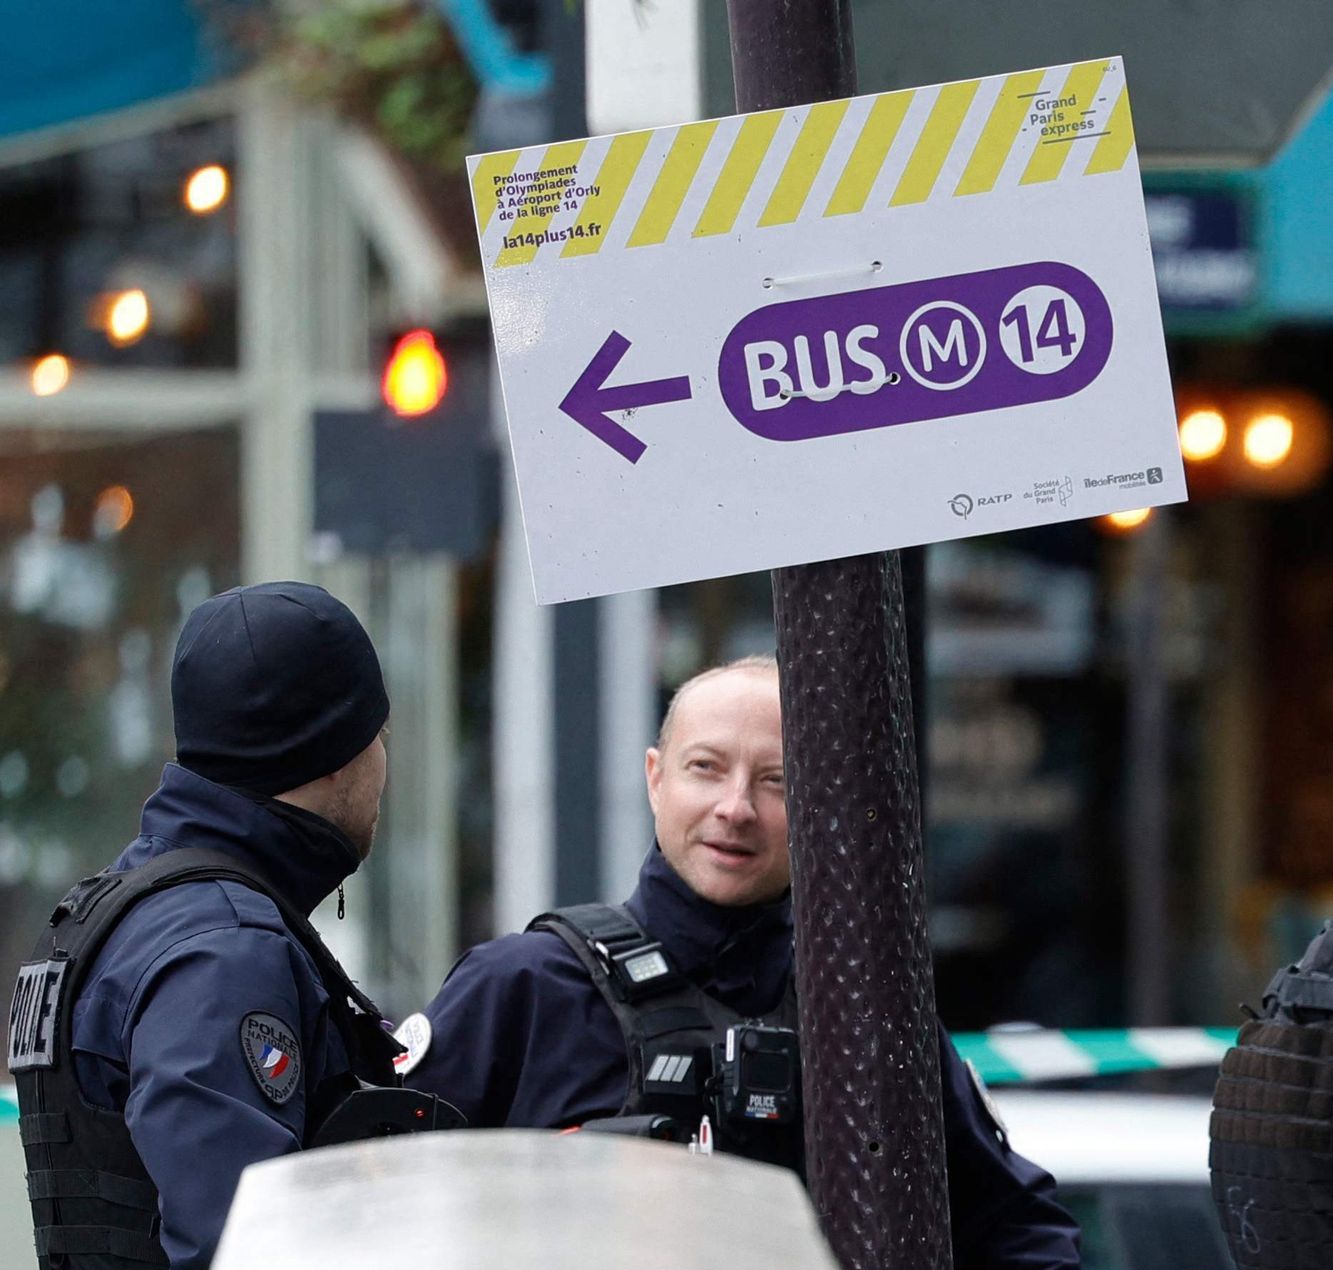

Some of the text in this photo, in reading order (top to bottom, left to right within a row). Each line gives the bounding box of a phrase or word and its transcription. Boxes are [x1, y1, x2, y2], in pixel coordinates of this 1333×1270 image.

[1036, 94, 1076, 110] Grand
[1030, 111, 1064, 125] Paris
[1041, 120, 1094, 136] express
[494, 165, 578, 185] Prolongement
[496, 178, 576, 198] d'Olympiades
[498, 186, 600, 208] à Aéroport d'Orly
[499, 201, 577, 220] de la ligne 14
[504, 223, 601, 248] la14plus14.fr
[742, 324, 885, 411] BUS
[1001, 299, 1078, 363] 14
[1034, 480, 1059, 489] Société
[1034, 488, 1055, 496] Grand
[978, 494, 1012, 506] RATP
[1036, 496, 1053, 504] Paris
[248, 1019, 298, 1052] POLICE
[750, 1094, 775, 1107] POLICE
